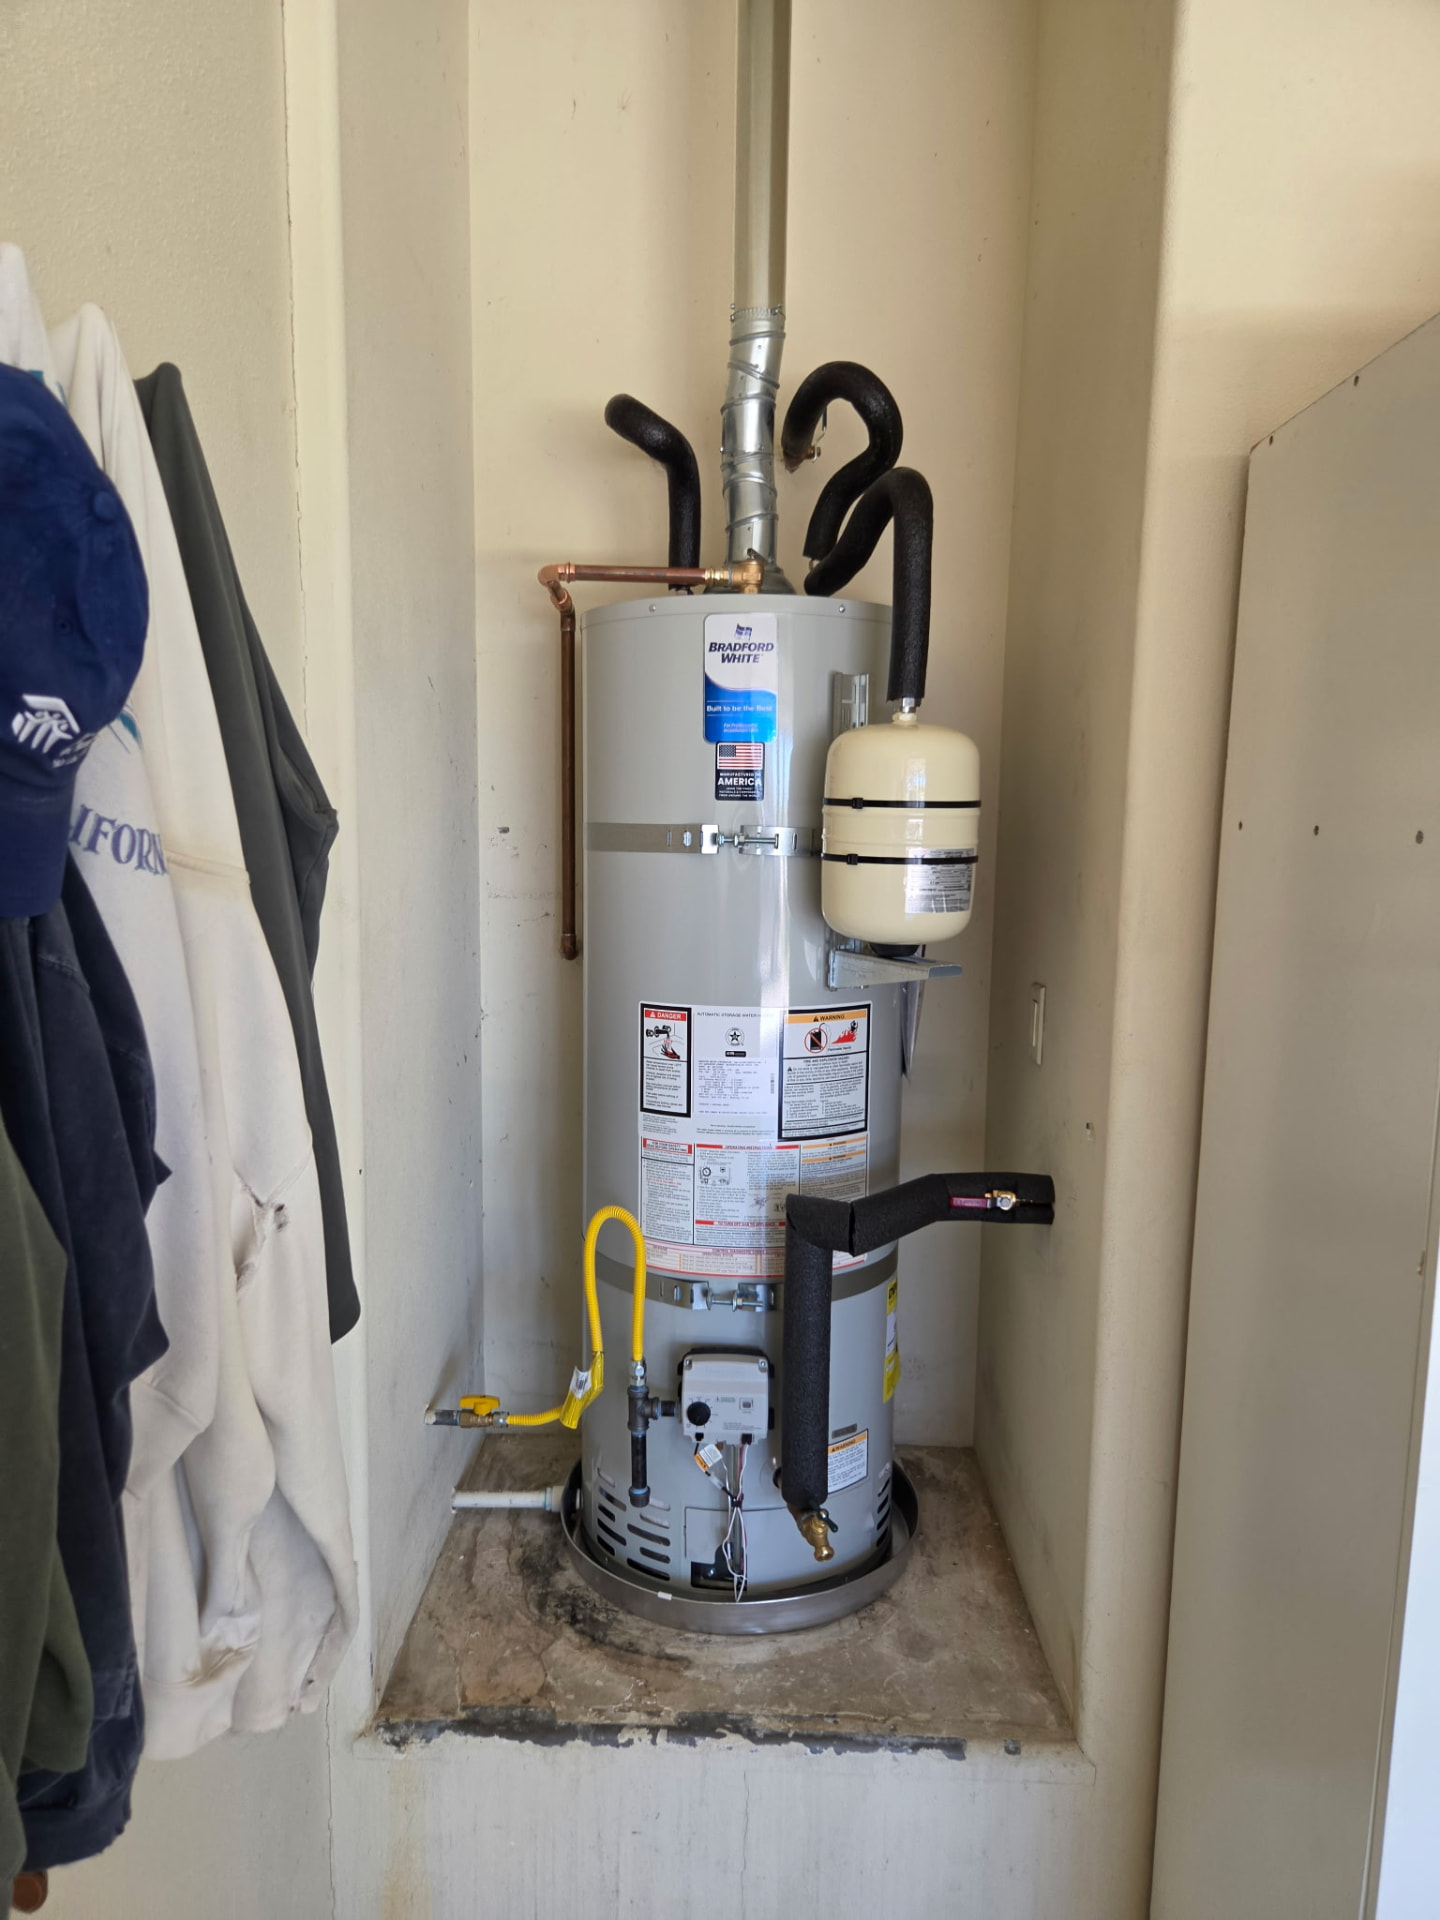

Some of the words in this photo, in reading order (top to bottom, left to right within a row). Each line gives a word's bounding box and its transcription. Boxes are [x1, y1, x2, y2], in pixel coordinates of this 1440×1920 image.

[708, 641, 775, 652] BRADFORD
[721, 652, 760, 664] WHITE
[717, 777, 762, 786] AMERICA
[67, 803, 168, 876] IFORN
[656, 1011, 683, 1020] DANGER
